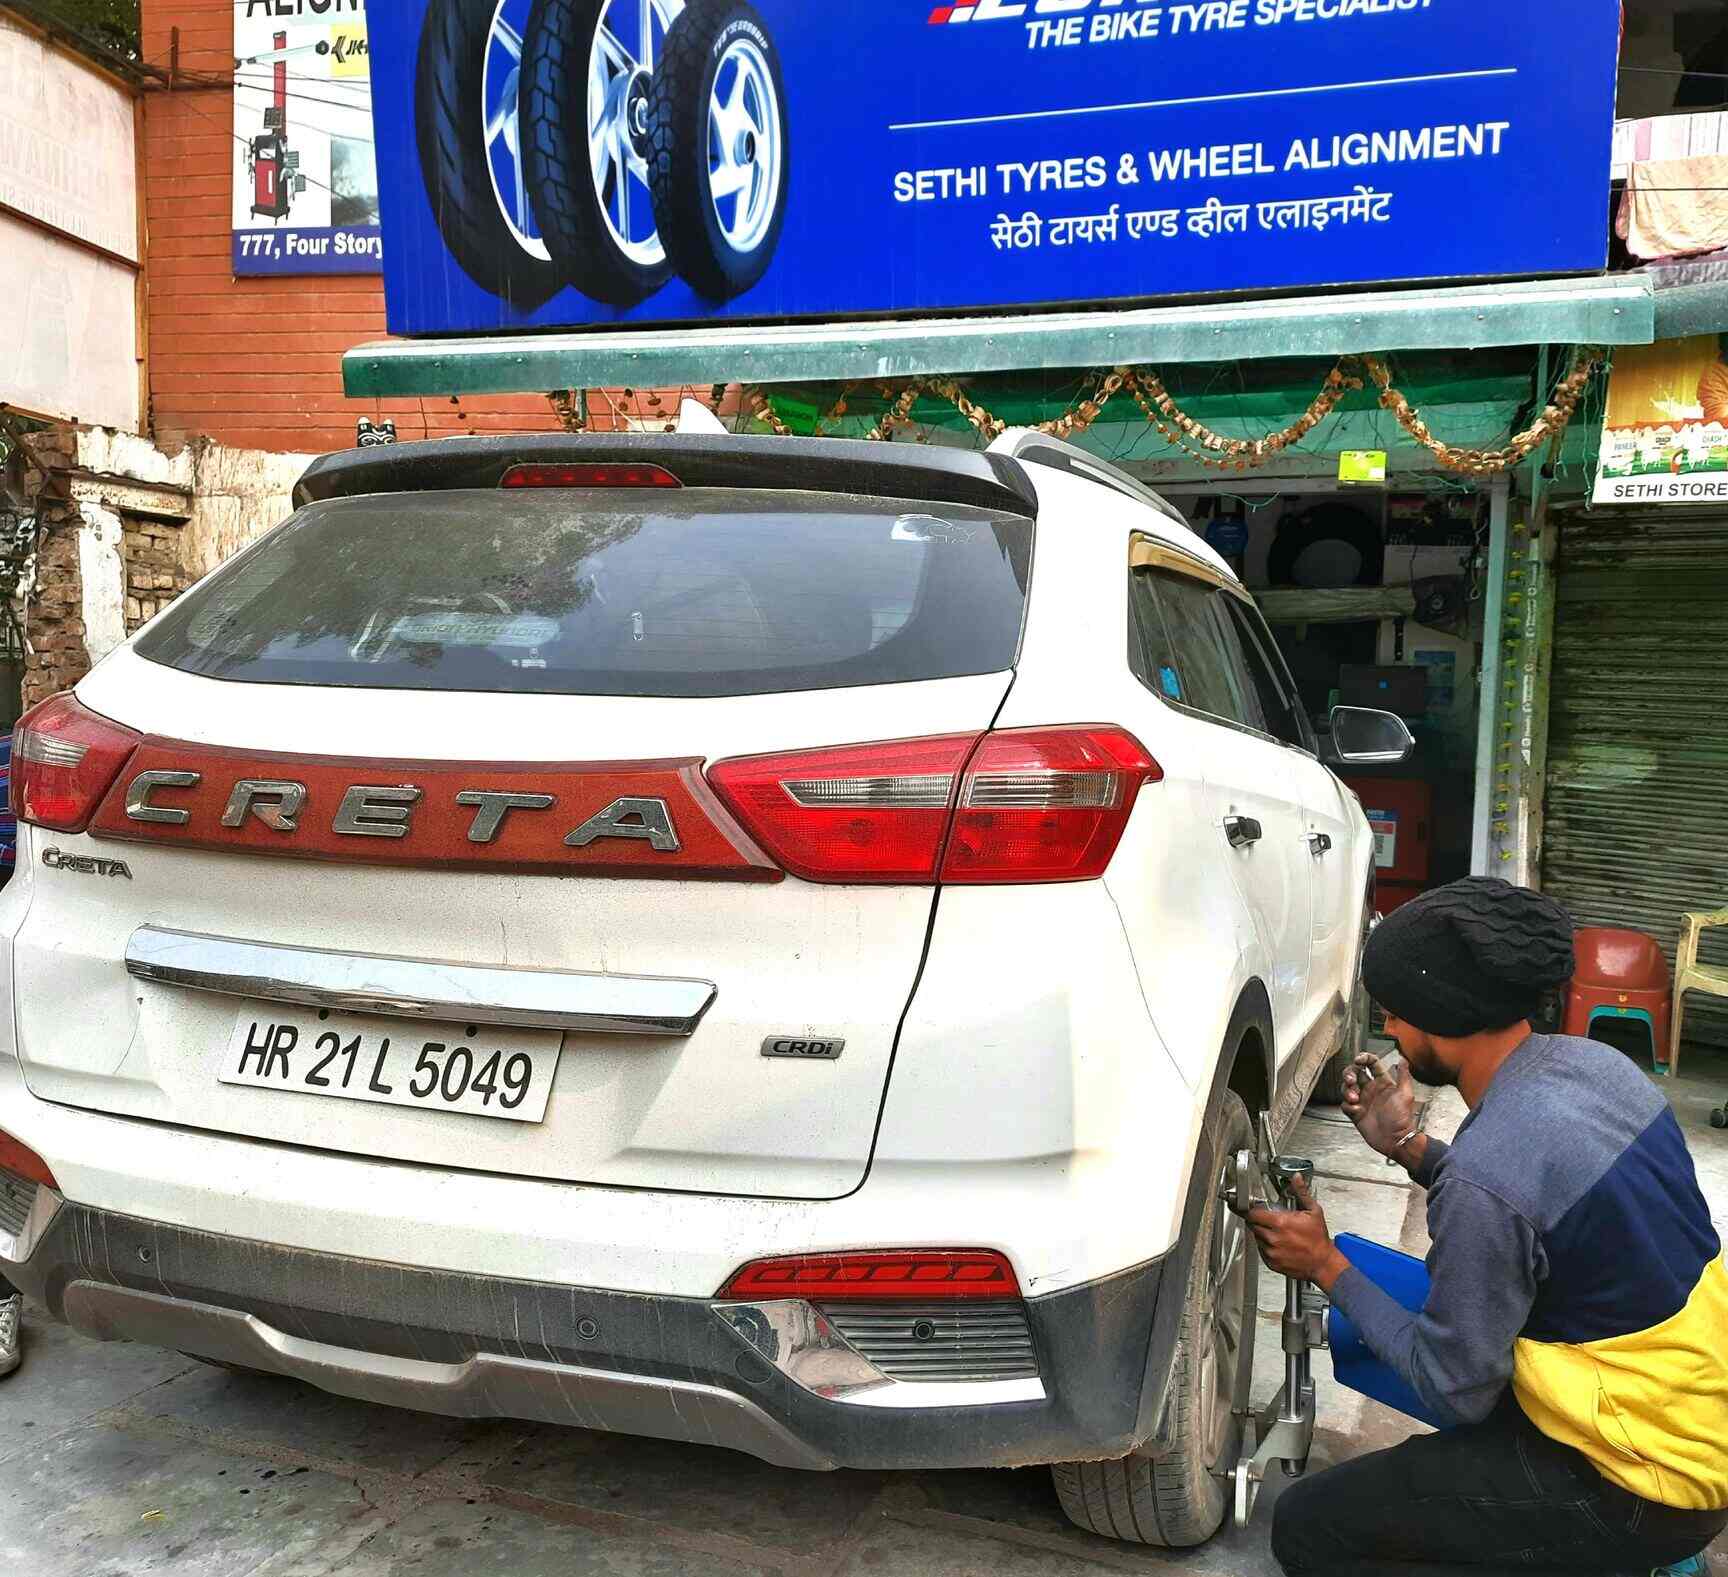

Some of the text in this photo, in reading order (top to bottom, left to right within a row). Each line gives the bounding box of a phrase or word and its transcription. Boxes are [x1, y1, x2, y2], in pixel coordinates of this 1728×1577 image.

[1025, 17, 1085, 49] THE
[1089, 8, 1163, 43] BIKE
[1168, 3, 1247, 34] TYRE
[1254, 0, 1431, 25] SPECIAL
[894, 122, 1510, 202] SETHI TYRES & WHEEL ALIGNMENT
[990, 186, 1393, 249] सेठी टायर्स एण्ड व्हील एलाइनमेंट
[239, 231, 383, 260] 777, Four Story
[1614, 482, 1728, 498] SETHI STORE
[126, 769, 681, 851] CRETA
[42, 846, 133, 880] CRETA
[238, 1022, 533, 1109] HR 21 L 5049
[773, 1040, 834, 1055] CRDi
